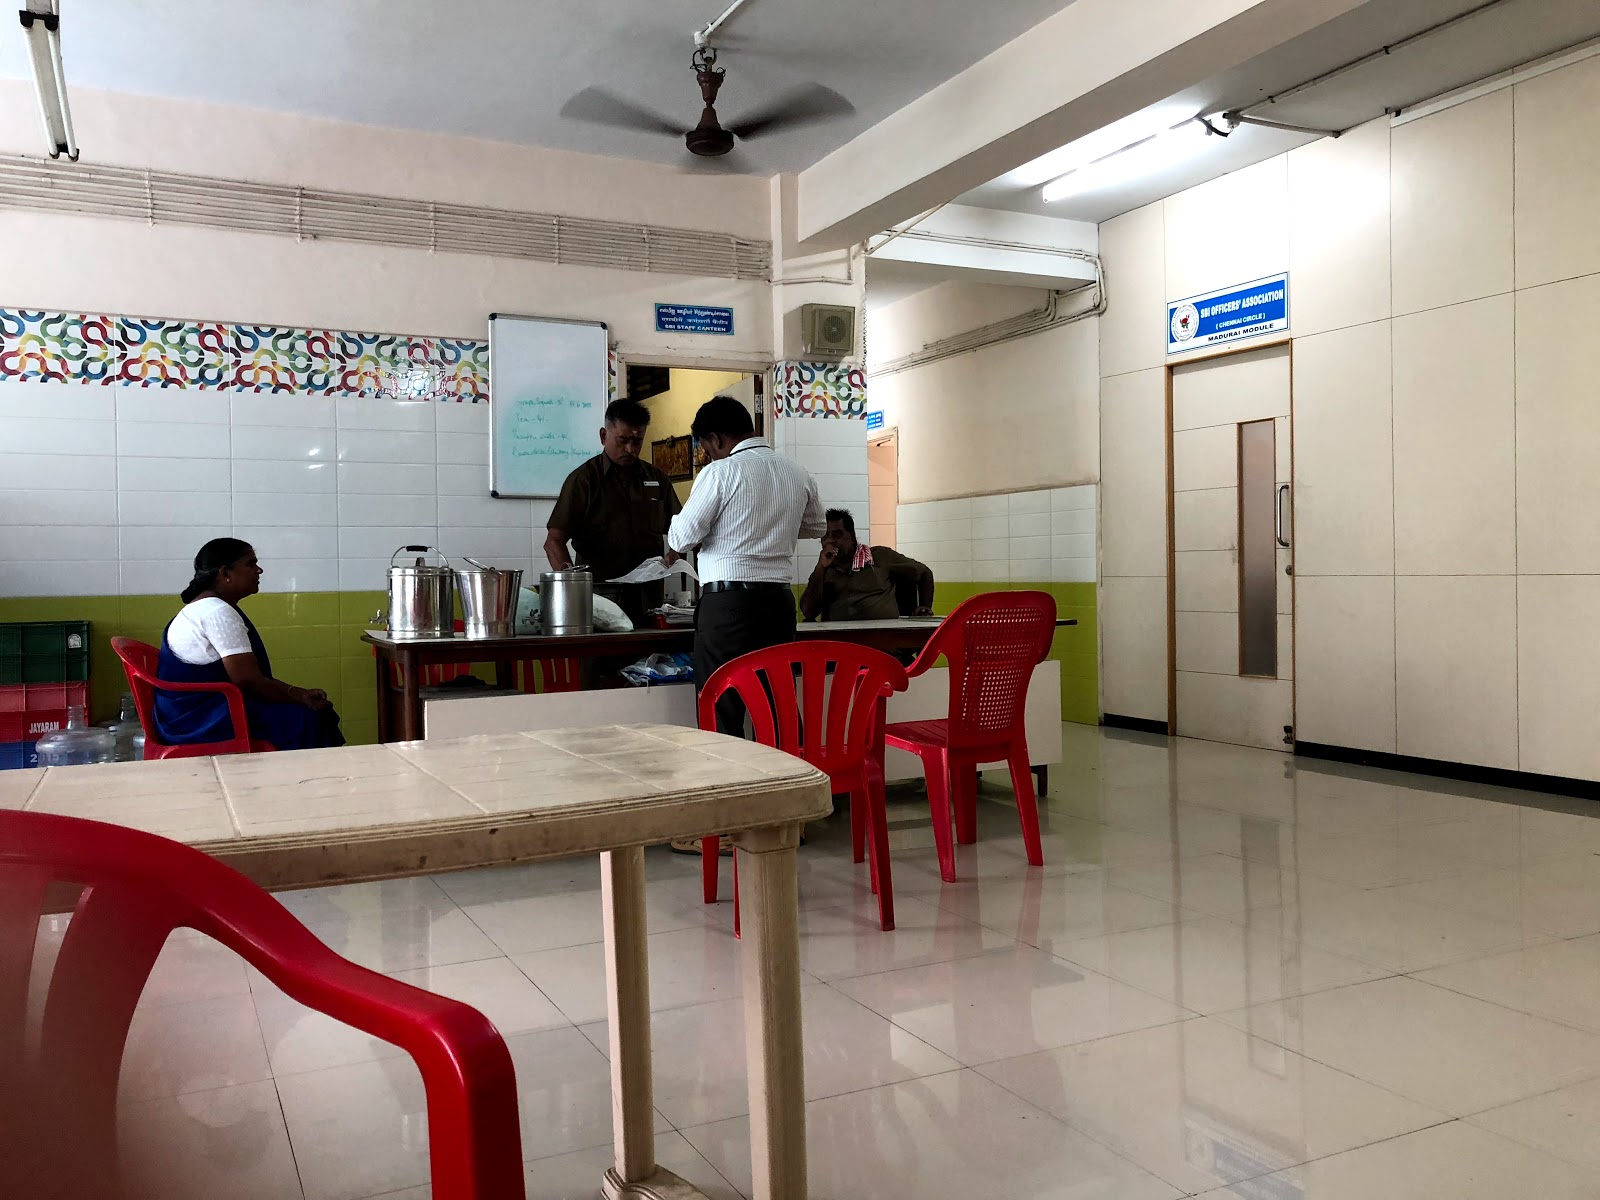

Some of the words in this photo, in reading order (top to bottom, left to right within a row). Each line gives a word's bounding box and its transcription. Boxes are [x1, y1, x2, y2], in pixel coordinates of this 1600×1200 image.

[1200, 308, 1210, 318] SBI
[1242, 289, 1284, 308] ASSOCIATION
[1208, 331, 1240, 341] MADURAI
[1243, 323, 1274, 337] MODULE
[29, 721, 59, 733] JAYARAM
